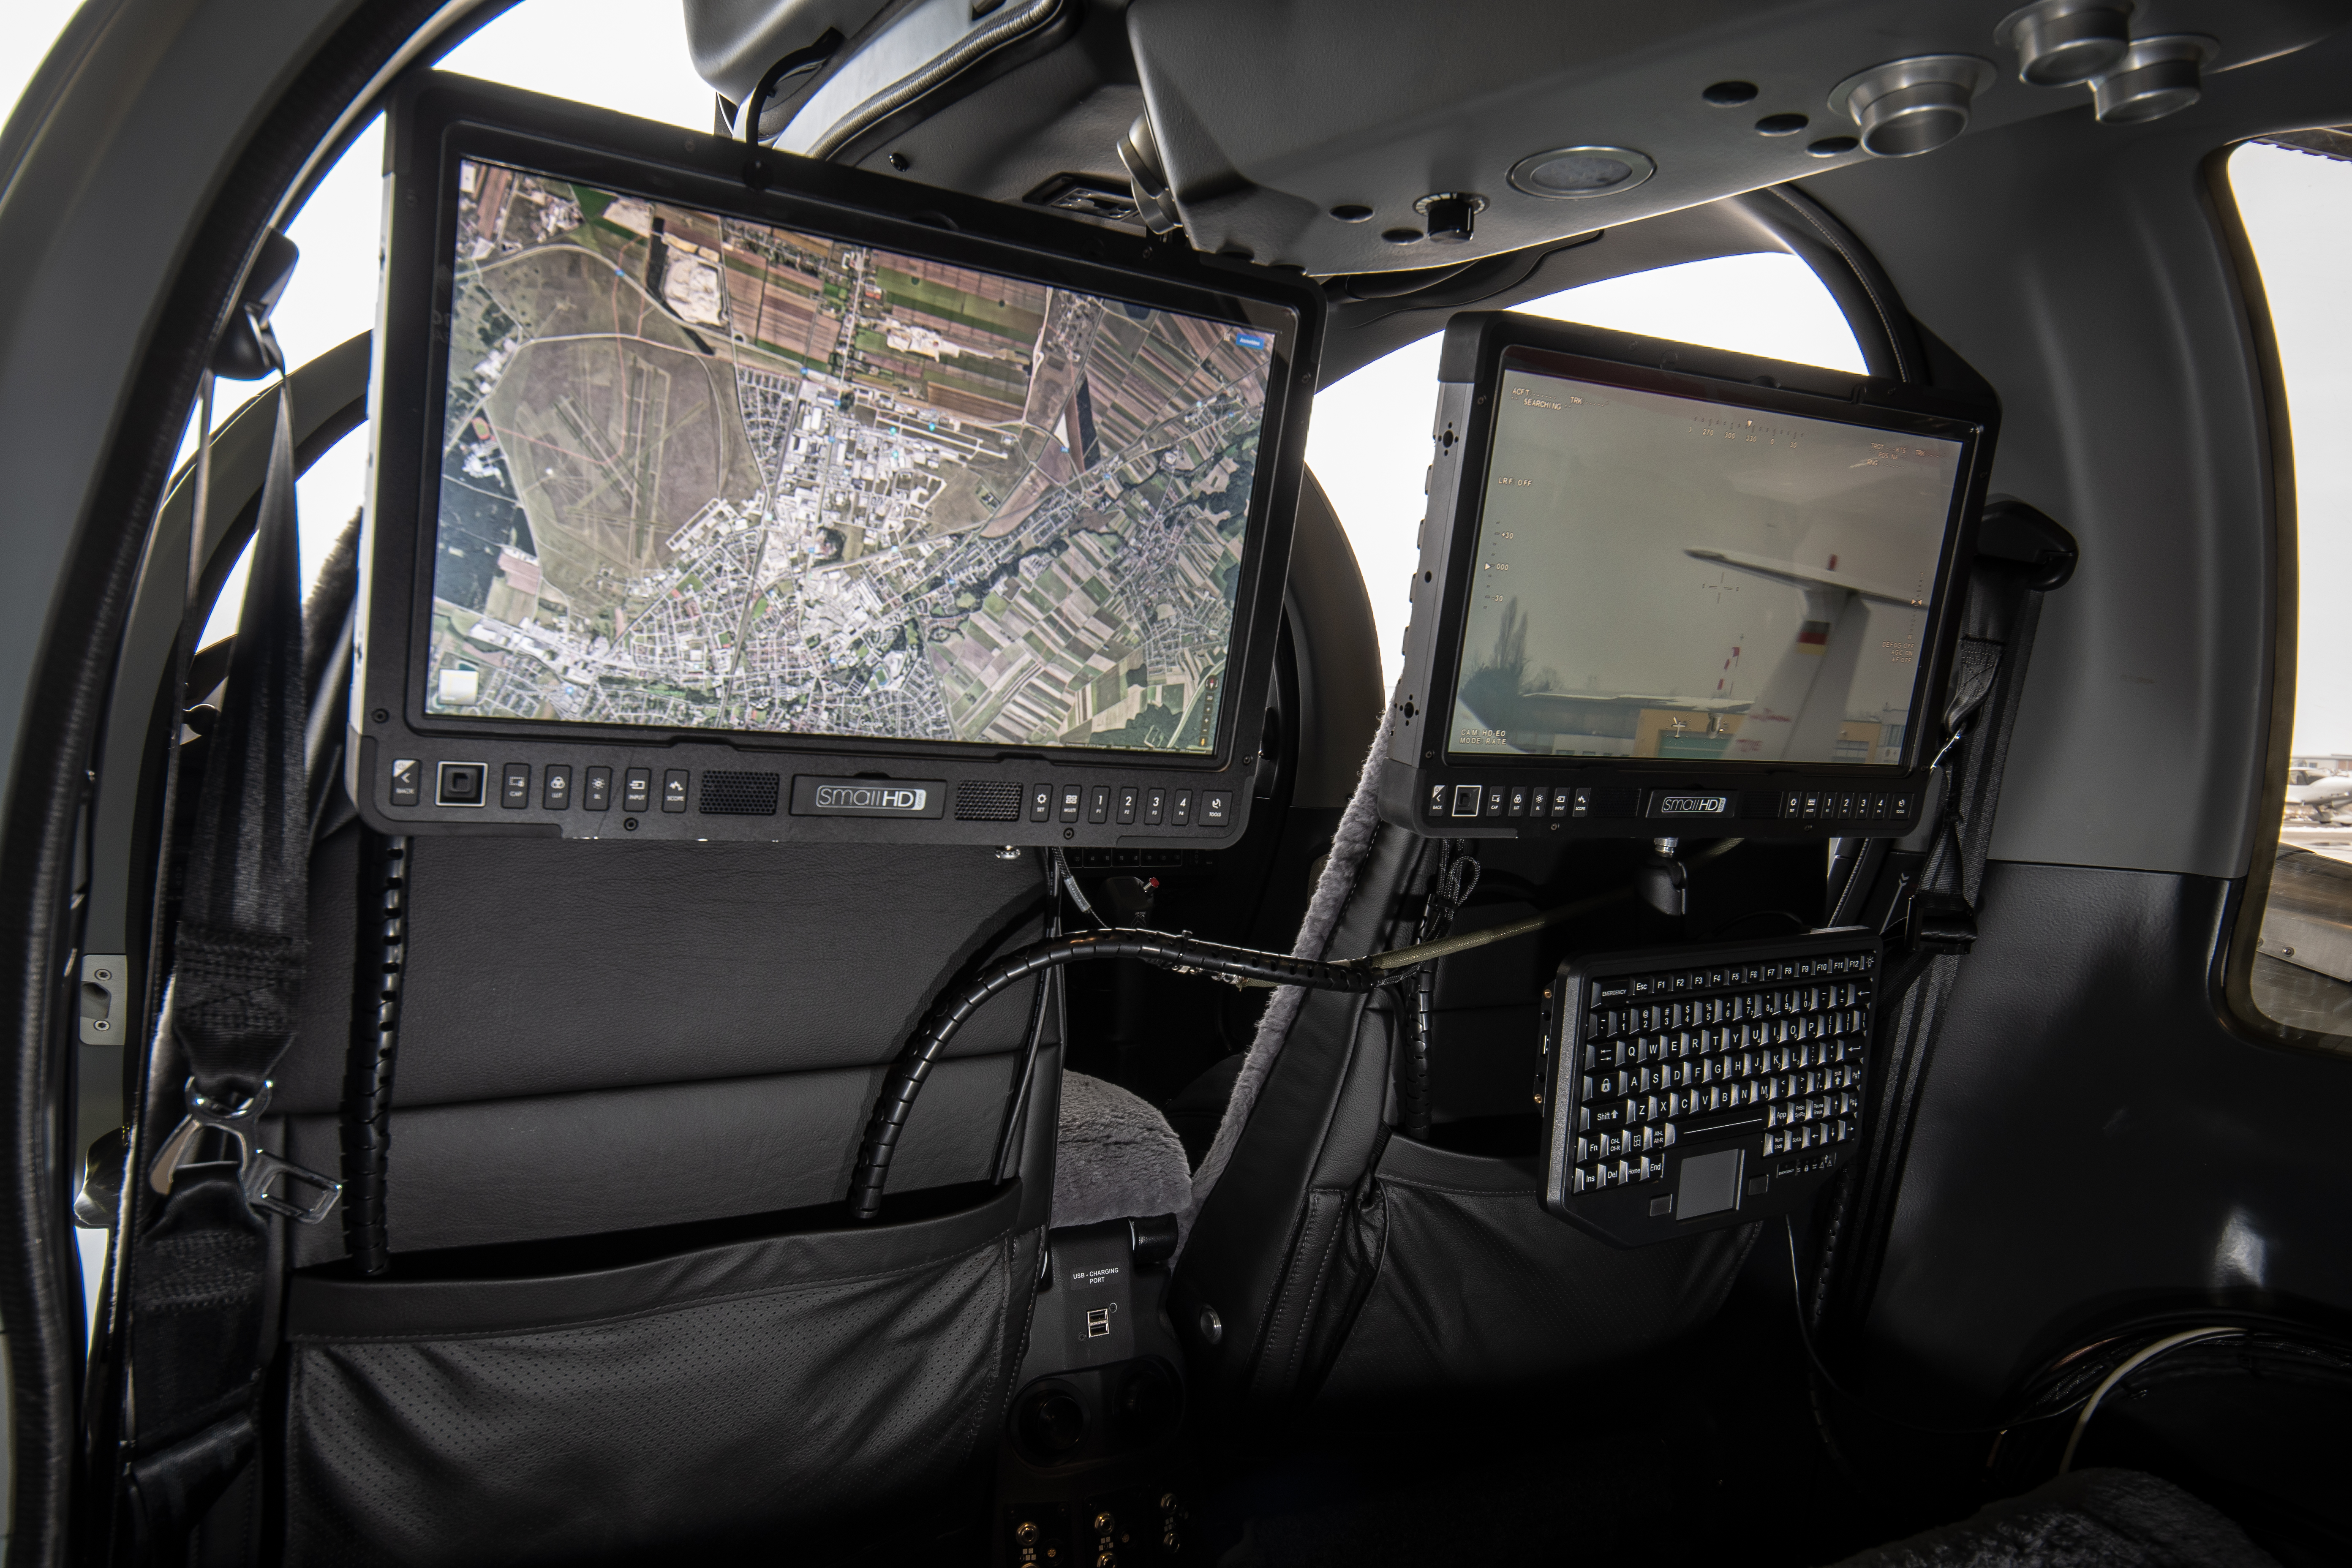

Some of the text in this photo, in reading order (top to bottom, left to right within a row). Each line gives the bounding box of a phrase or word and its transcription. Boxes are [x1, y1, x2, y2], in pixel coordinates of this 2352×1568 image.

[1523, 398, 1562, 410] SEARCHING
[1702, 428, 1714, 436] 270
[1518, 479, 1532, 487] OFF
[1502, 531, 1514, 539] +30
[1496, 563, 1509, 571] 000
[1099, 795, 1103, 805] 1
[1125, 796, 1132, 806] 2
[1153, 797, 1159, 807] 3
[1180, 798, 1186, 807] 4
[1069, 882, 1087, 908] MONITOR
[1774, 1027, 1776, 1036] I
[1790, 1025, 1796, 1034] O
[1809, 1023, 1814, 1032] P
[1733, 1034, 1739, 1043] Y
[1753, 1030, 1759, 1039] U
[1692, 1039, 1698, 1048] R
[1713, 1036, 1719, 1045] T
[1649, 1044, 1658, 1054] W
[1671, 1041, 1677, 1051] E
[1628, 1046, 1635, 1056] Q
[1755, 1057, 1759, 1066] J
[1774, 1055, 1779, 1064] K
[1793, 1053, 1797, 1061] L
[1715, 1064, 1721, 1073] G
[1735, 1061, 1741, 1070] H
[1674, 1071, 1680, 1080] D
[1695, 1067, 1701, 1077] F
[1631, 1077, 1638, 1086] A
[1653, 1074, 1659, 1083] S
[1742, 1089, 1748, 1099] N
[1761, 1086, 1768, 1095] M
[1702, 1095, 1709, 1105] V
[1722, 1093, 1727, 1102] B
[1661, 1101, 1667, 1111] X
[1681, 1099, 1688, 1108] C
[1639, 1105, 1645, 1115] Z
[1597, 1112, 1611, 1121] Shift
[1650, 1162, 1661, 1171] End
[1607, 1170, 1617, 1179] Del
[1089, 1267, 1119, 1277] CHARGING
